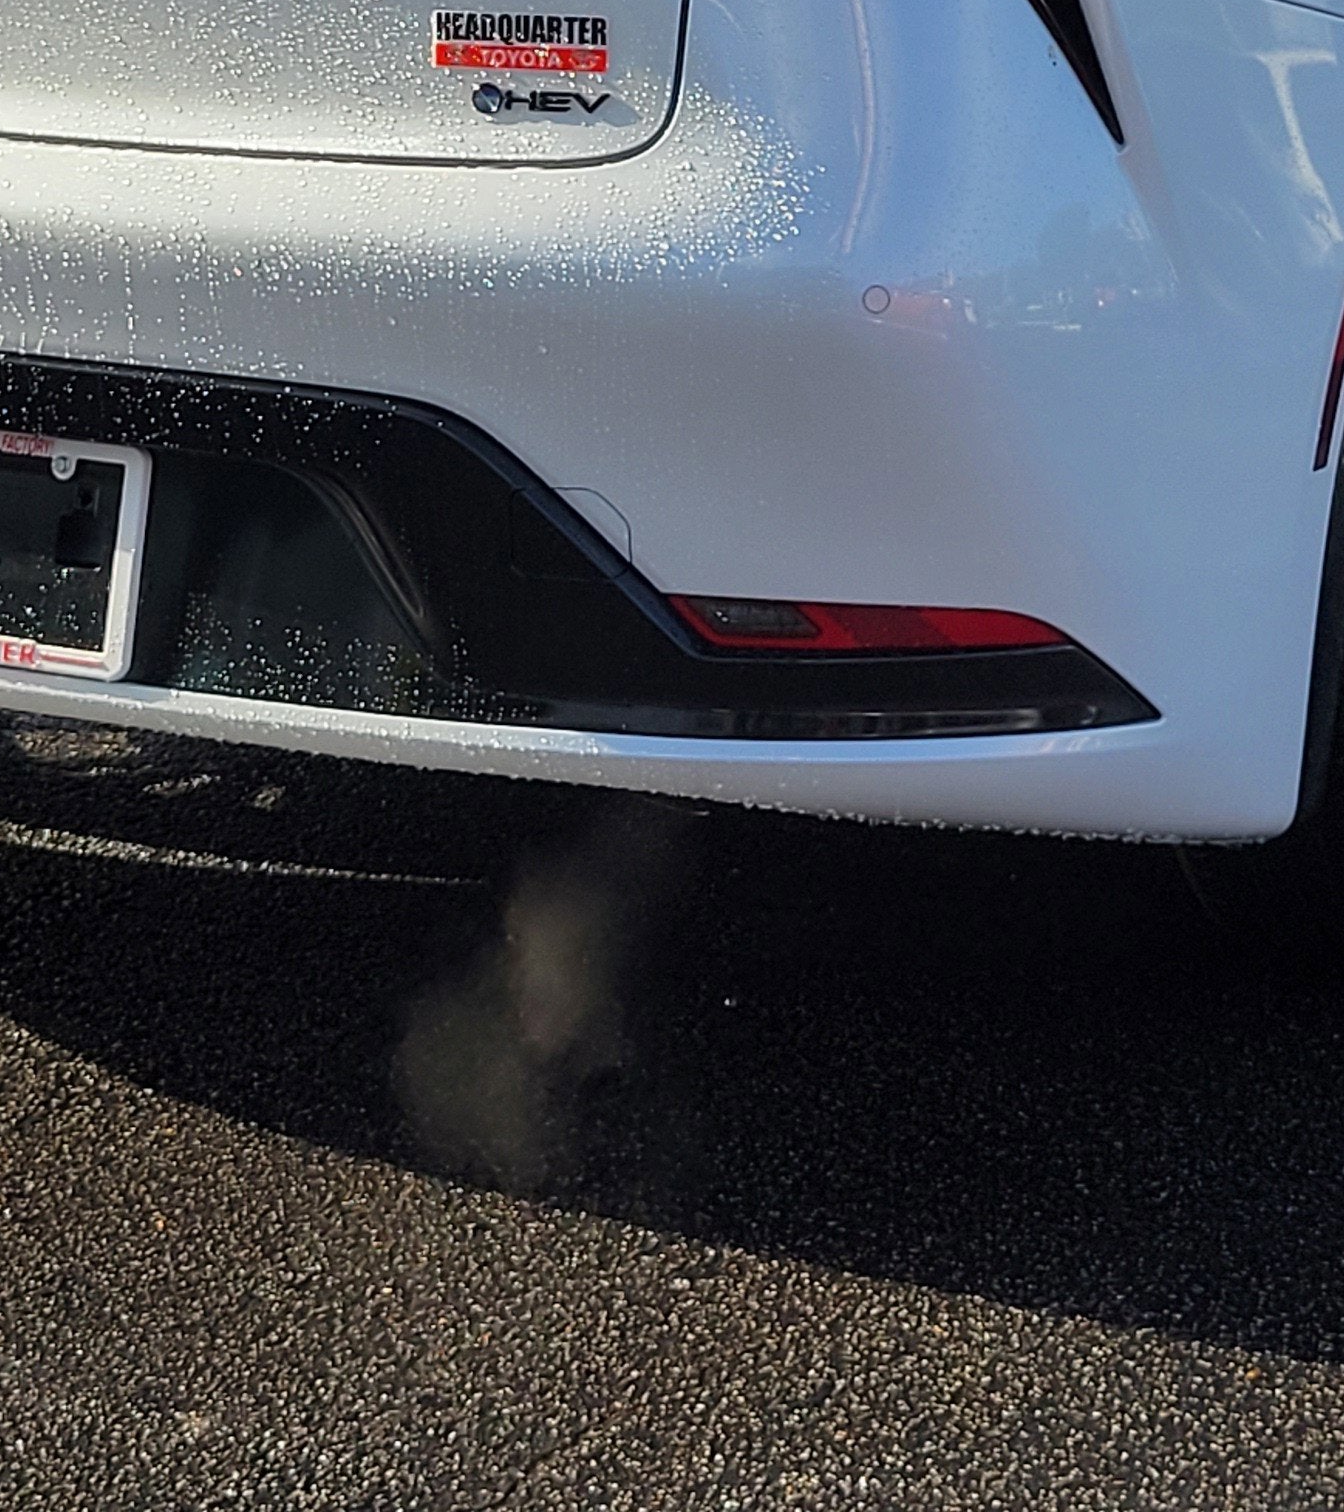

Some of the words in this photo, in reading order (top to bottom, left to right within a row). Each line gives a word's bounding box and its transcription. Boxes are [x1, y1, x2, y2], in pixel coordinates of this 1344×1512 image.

[436, 12, 607, 46] HEADQUARTER
[480, 47, 562, 68] TOYOTA
[505, 90, 610, 114] HEV
